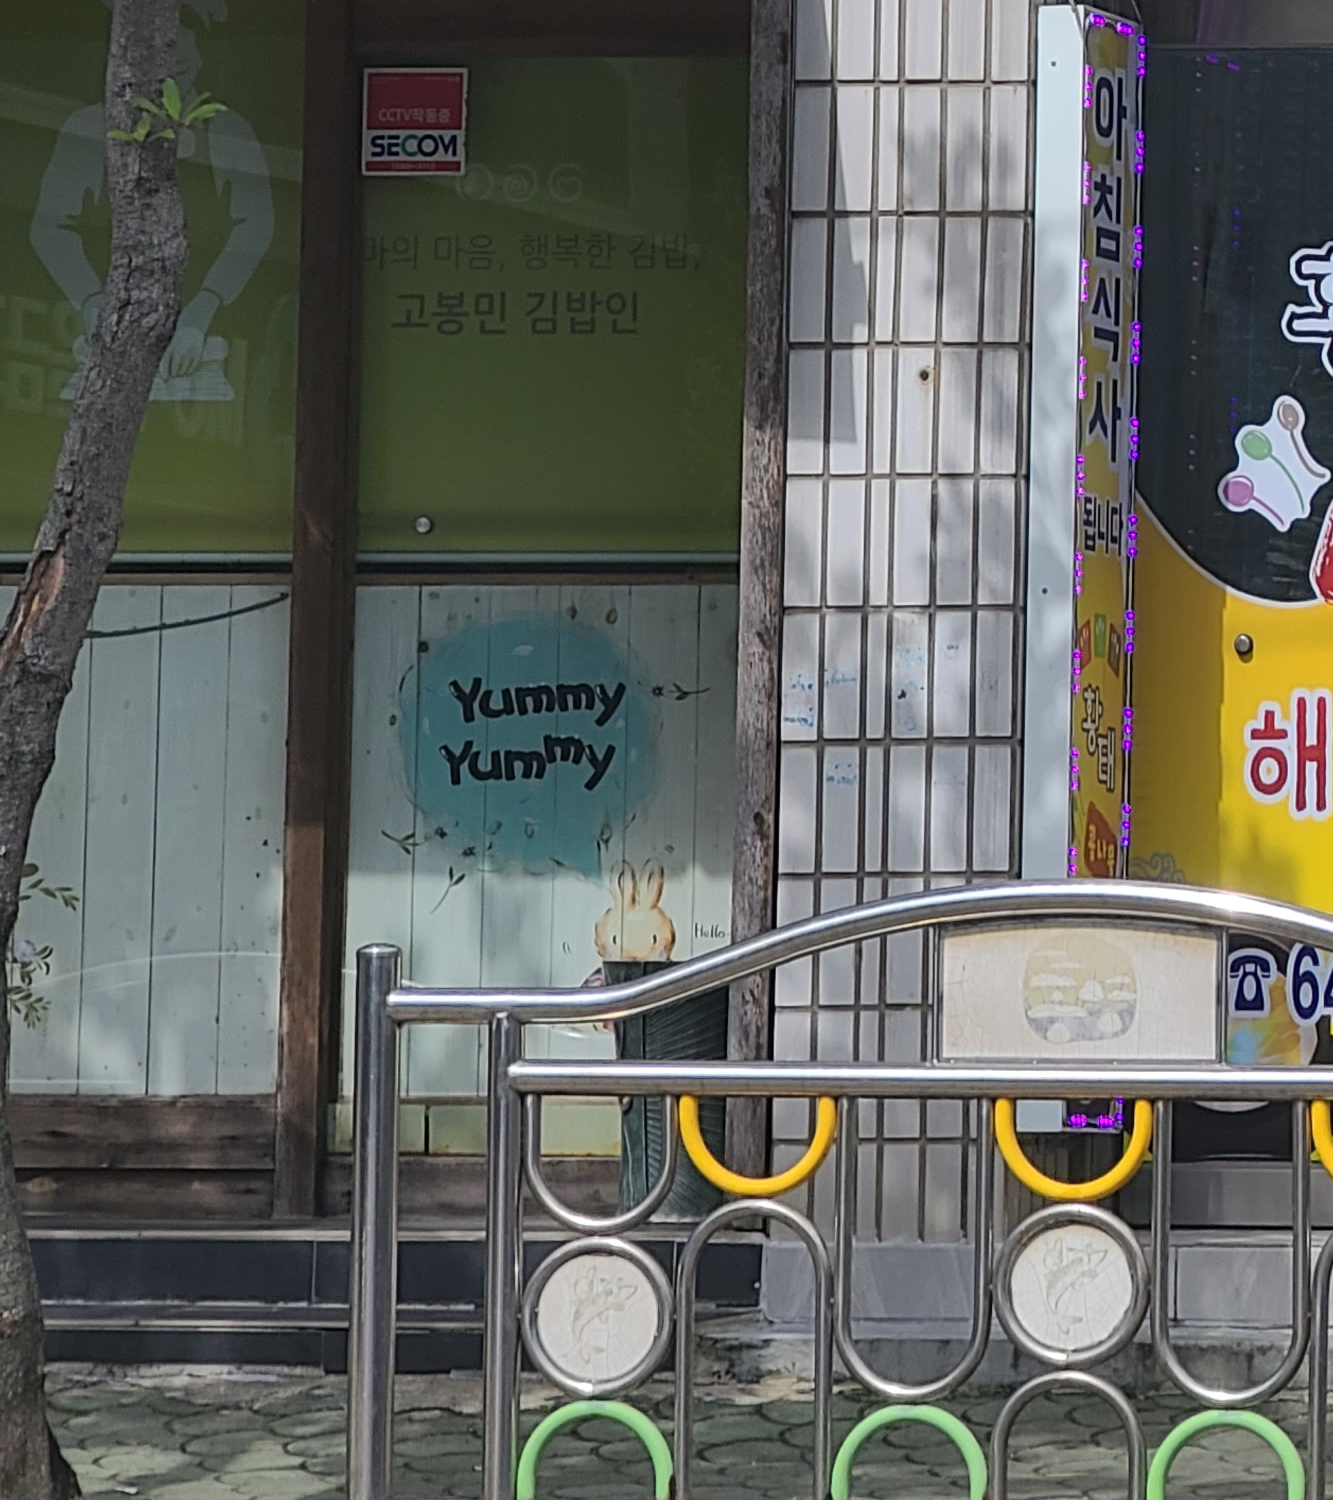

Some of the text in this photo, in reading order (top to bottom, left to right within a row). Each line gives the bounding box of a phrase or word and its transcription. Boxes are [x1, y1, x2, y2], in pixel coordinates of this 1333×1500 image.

[370, 134, 458, 157] SECOM
[519, 234, 617, 271] 행복한
[1089, 74, 1129, 465] 아침식사
[391, 291, 640, 335] 고봉민 김밥인
[1083, 496, 1124, 557] 됩니다
[448, 677, 627, 727] Yummy
[439, 733, 617, 791] Yummy
[1082, 684, 1116, 793] 황태
[694, 922, 727, 939] Hello
